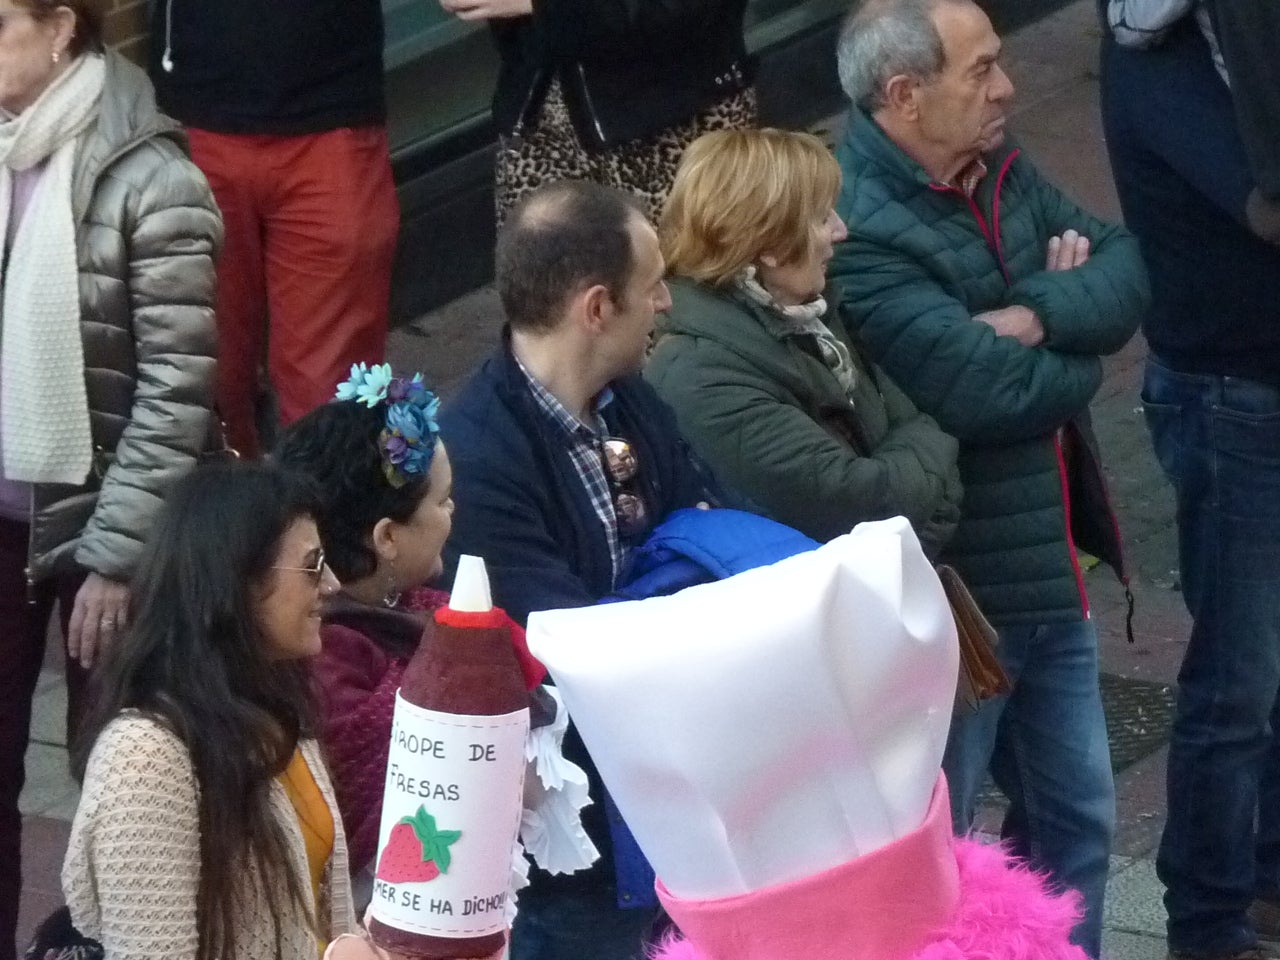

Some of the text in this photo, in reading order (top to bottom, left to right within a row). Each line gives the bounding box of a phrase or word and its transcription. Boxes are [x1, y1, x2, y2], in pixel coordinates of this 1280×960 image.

[468, 744, 496, 761] DE
[390, 763, 460, 801] FRESAS
[401, 891, 420, 911] SE
[430, 899, 453, 916] HA
